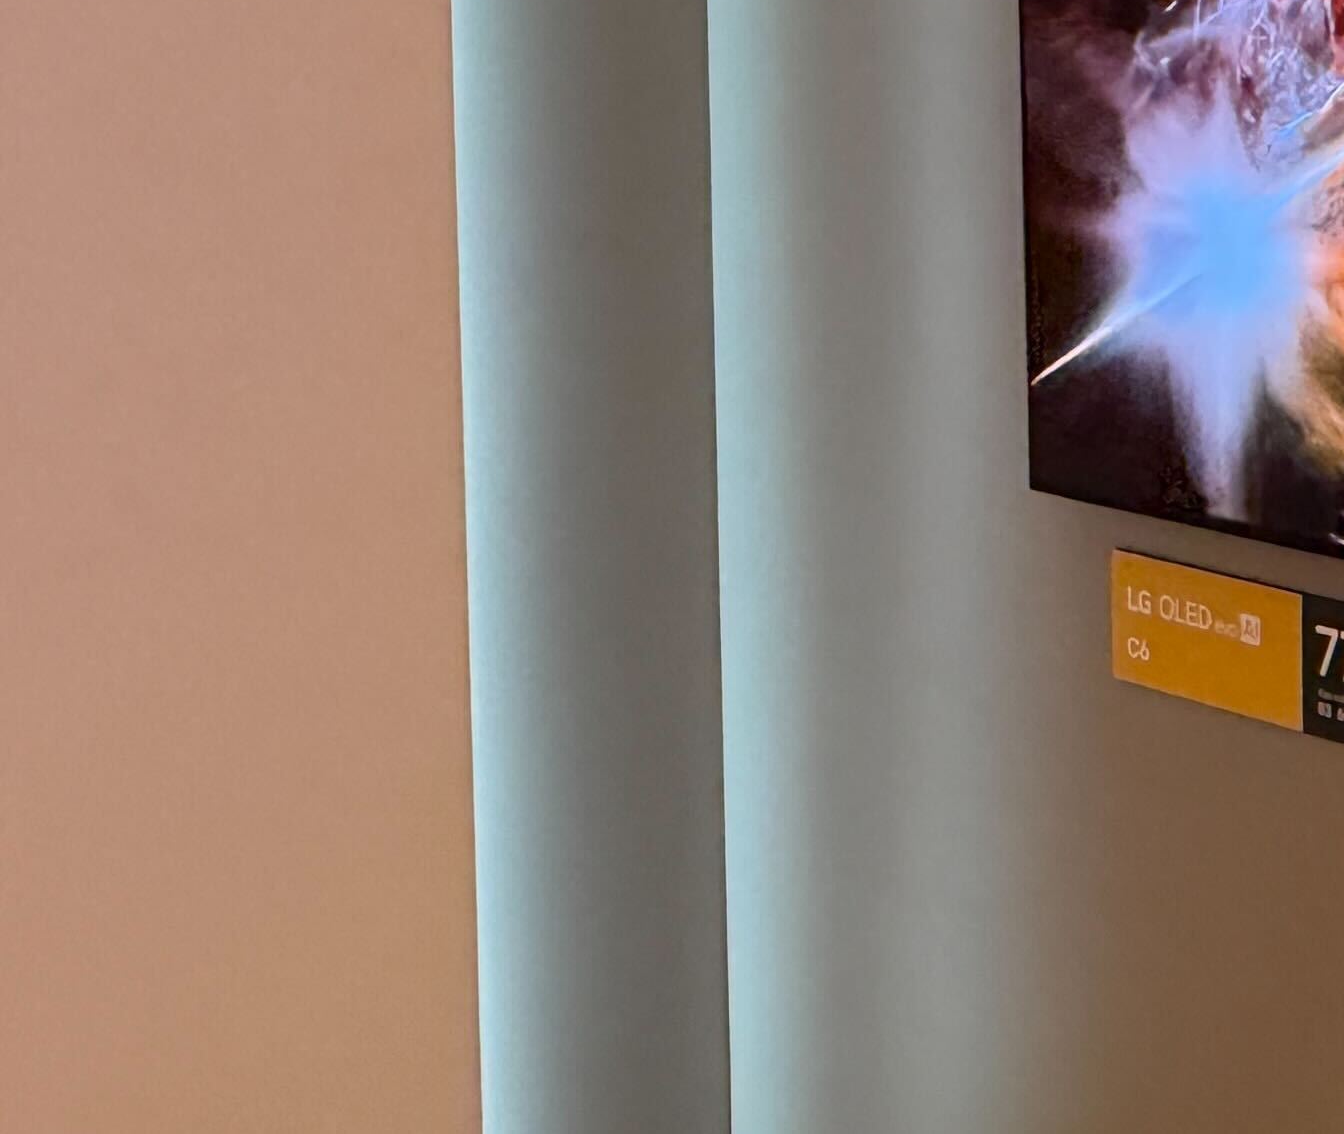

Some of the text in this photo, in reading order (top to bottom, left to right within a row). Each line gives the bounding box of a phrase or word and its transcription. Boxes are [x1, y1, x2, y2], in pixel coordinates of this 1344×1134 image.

[1126, 586, 1152, 615] LG
[1159, 595, 1213, 630] OLED
[1127, 637, 1150, 661] C6
